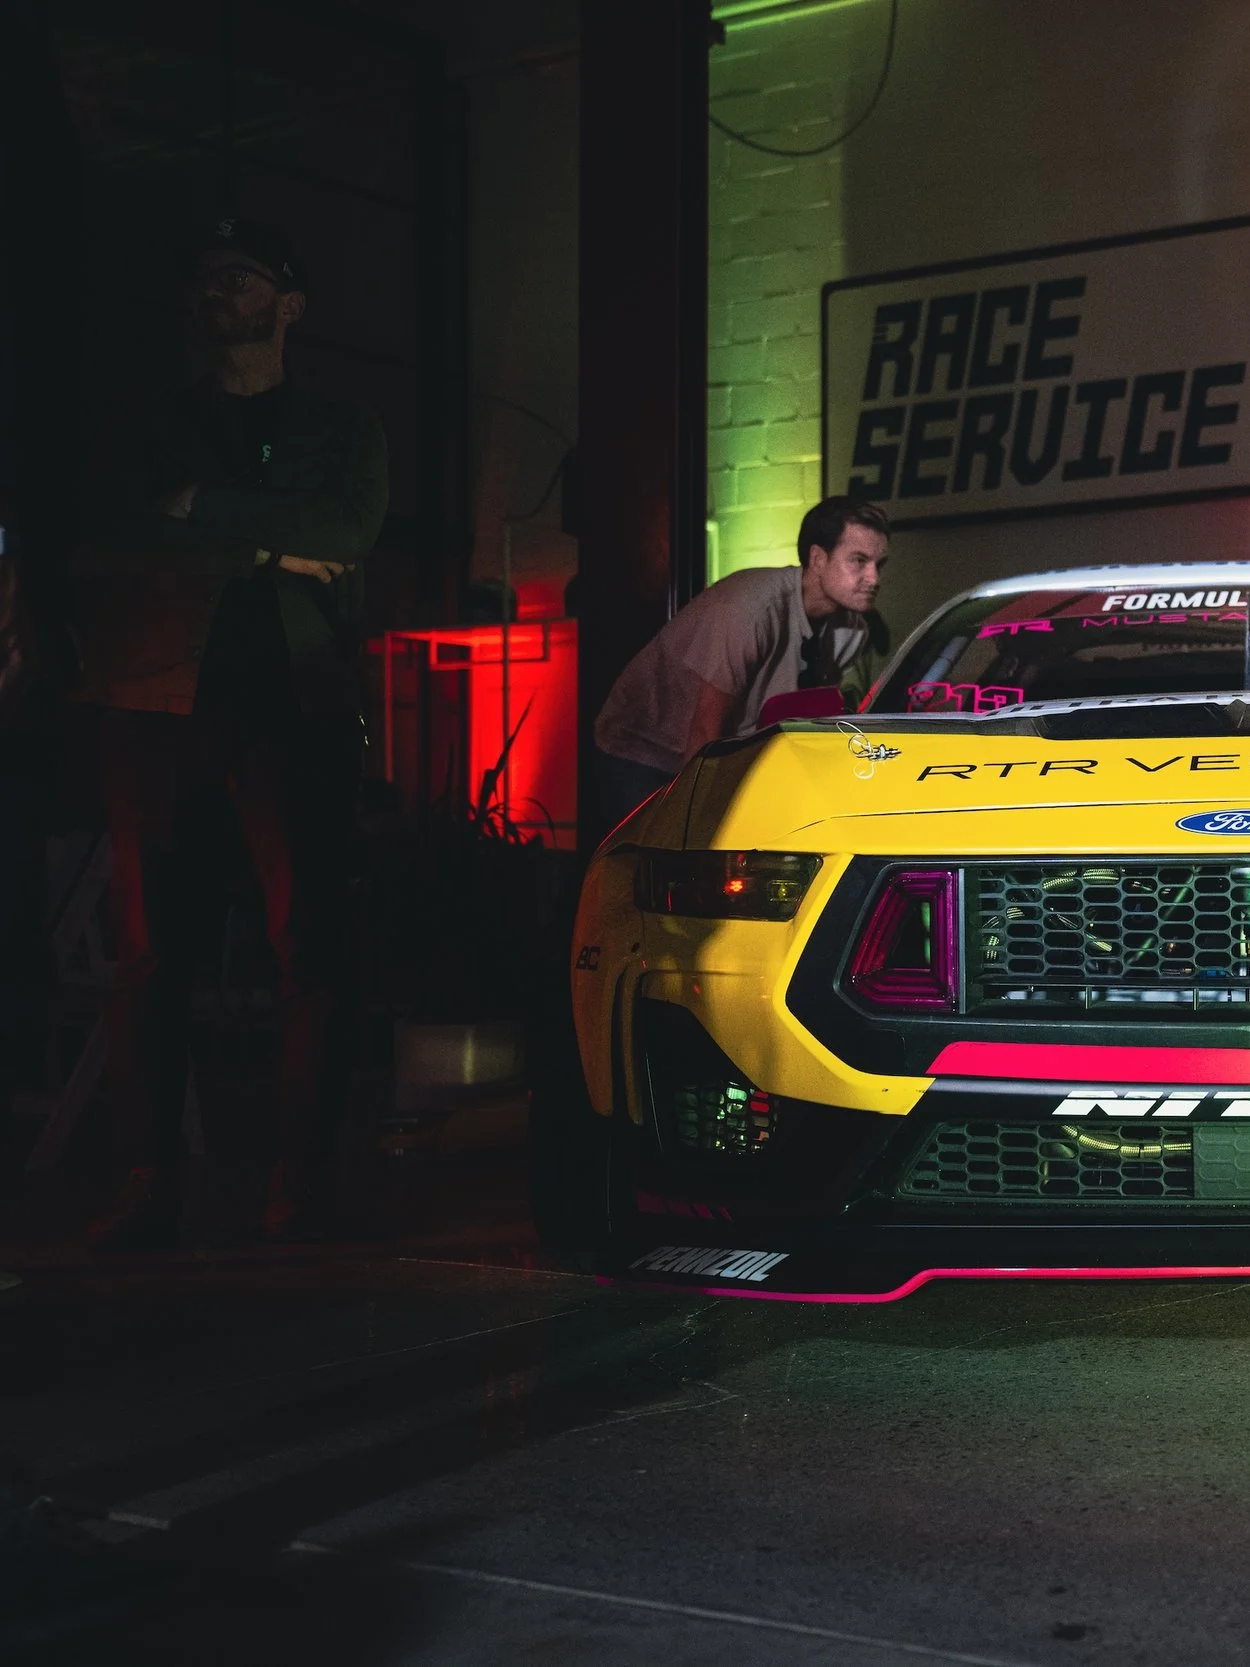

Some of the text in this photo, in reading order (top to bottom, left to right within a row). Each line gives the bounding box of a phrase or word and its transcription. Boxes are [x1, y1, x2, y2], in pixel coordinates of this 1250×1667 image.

[863, 277, 1086, 400] RACE
[847, 362, 1246, 499] SERVICE
[916, 759, 1099, 781] RTR
[629, 1246, 790, 1282] PENNZOIL
